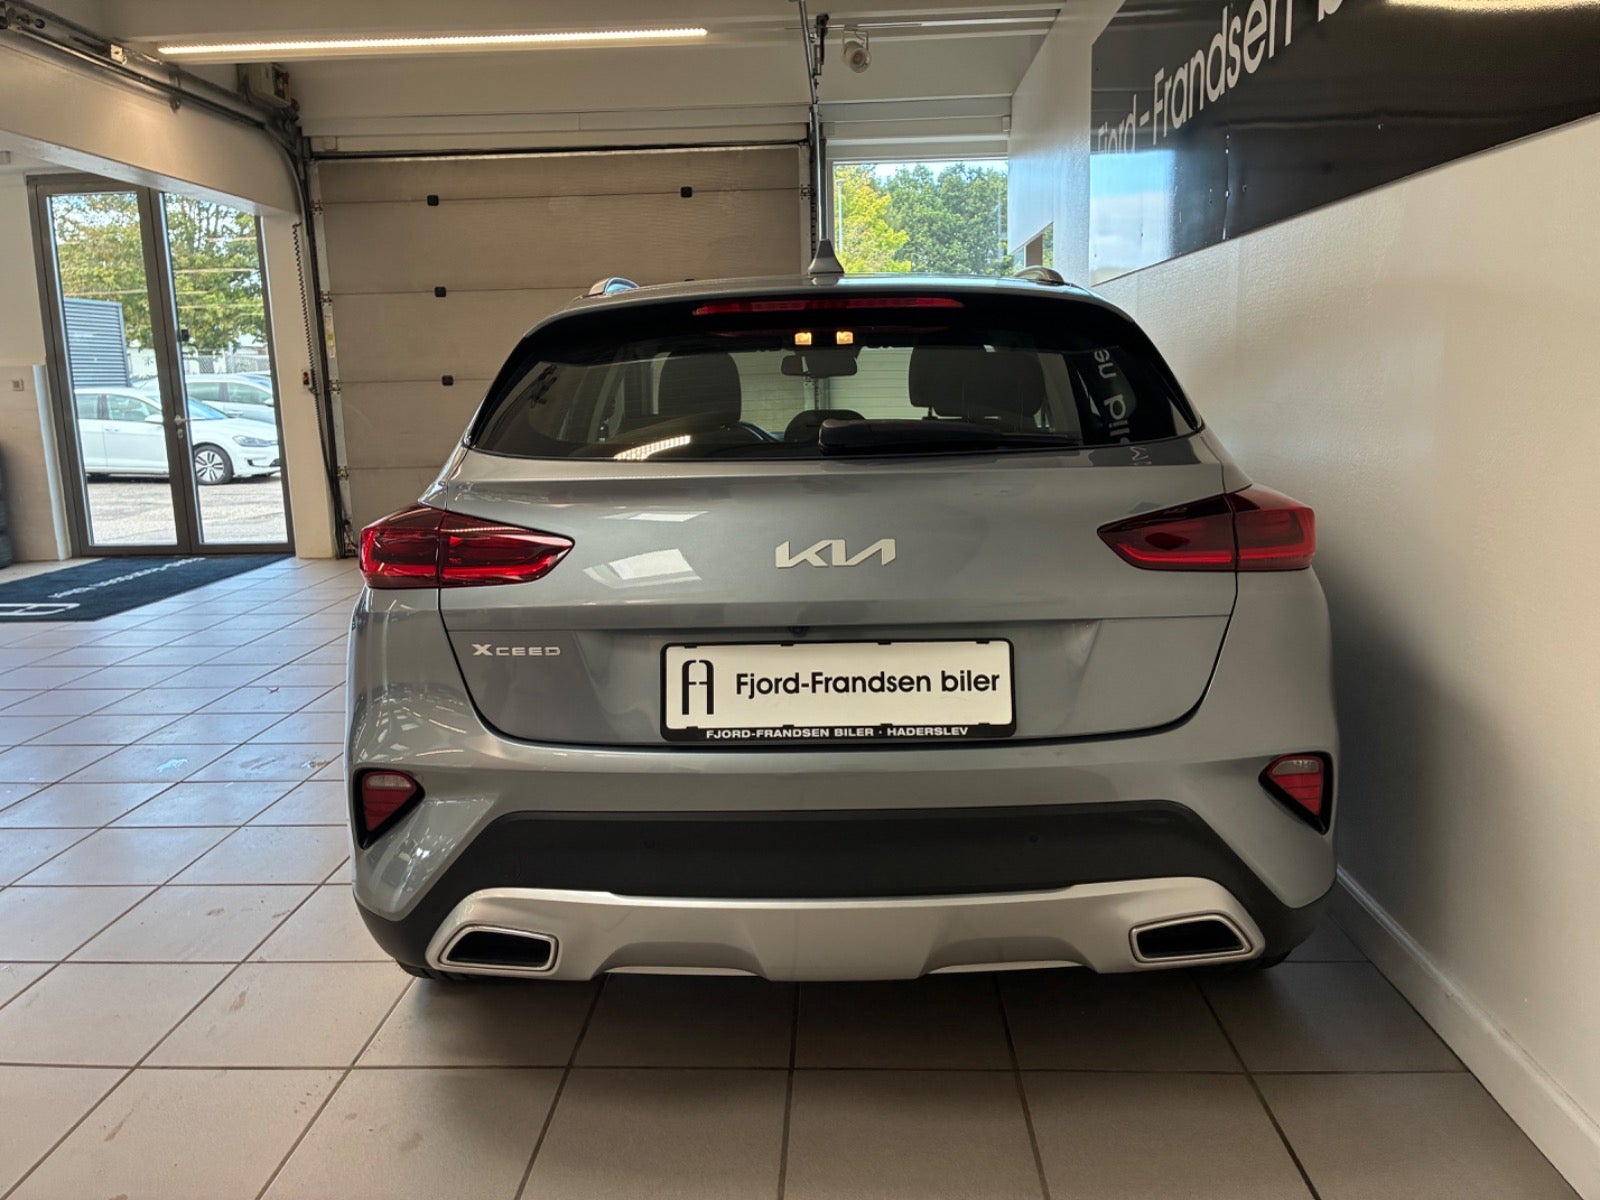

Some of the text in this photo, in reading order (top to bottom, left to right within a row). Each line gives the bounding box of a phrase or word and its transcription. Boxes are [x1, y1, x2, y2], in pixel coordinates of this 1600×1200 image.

[775, 538, 896, 568] KIA
[472, 643, 561, 657] XCEED
[735, 670, 1000, 700] Fjord-Frandsen biler
[706, 726, 969, 739] FJORD-FRANDSEN BILER HADERSLEV
